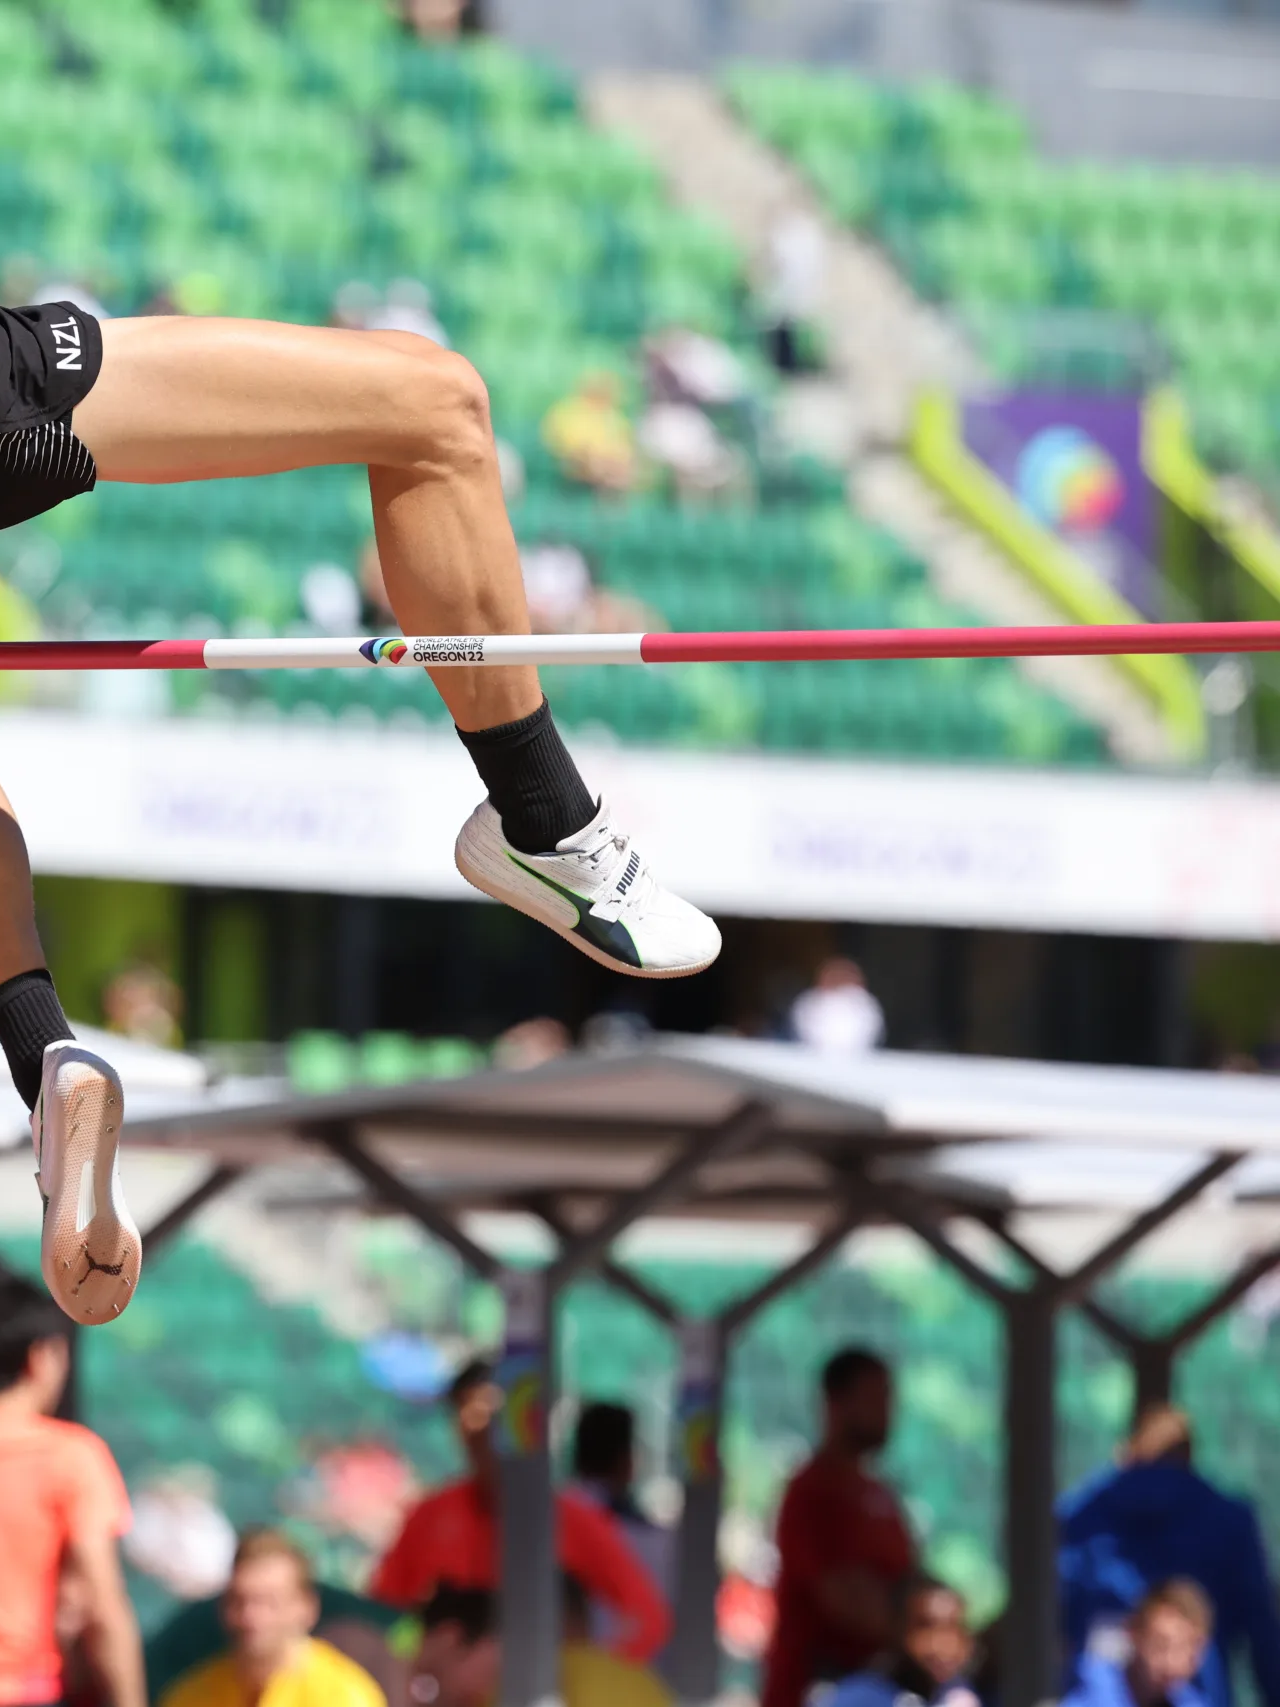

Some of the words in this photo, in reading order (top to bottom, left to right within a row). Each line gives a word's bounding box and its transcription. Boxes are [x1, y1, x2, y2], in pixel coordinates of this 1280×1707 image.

[49, 315, 83, 371] NZL
[413, 643, 483, 651] CHAMPIONSHIPS
[616, 850, 641, 896] PUMA
